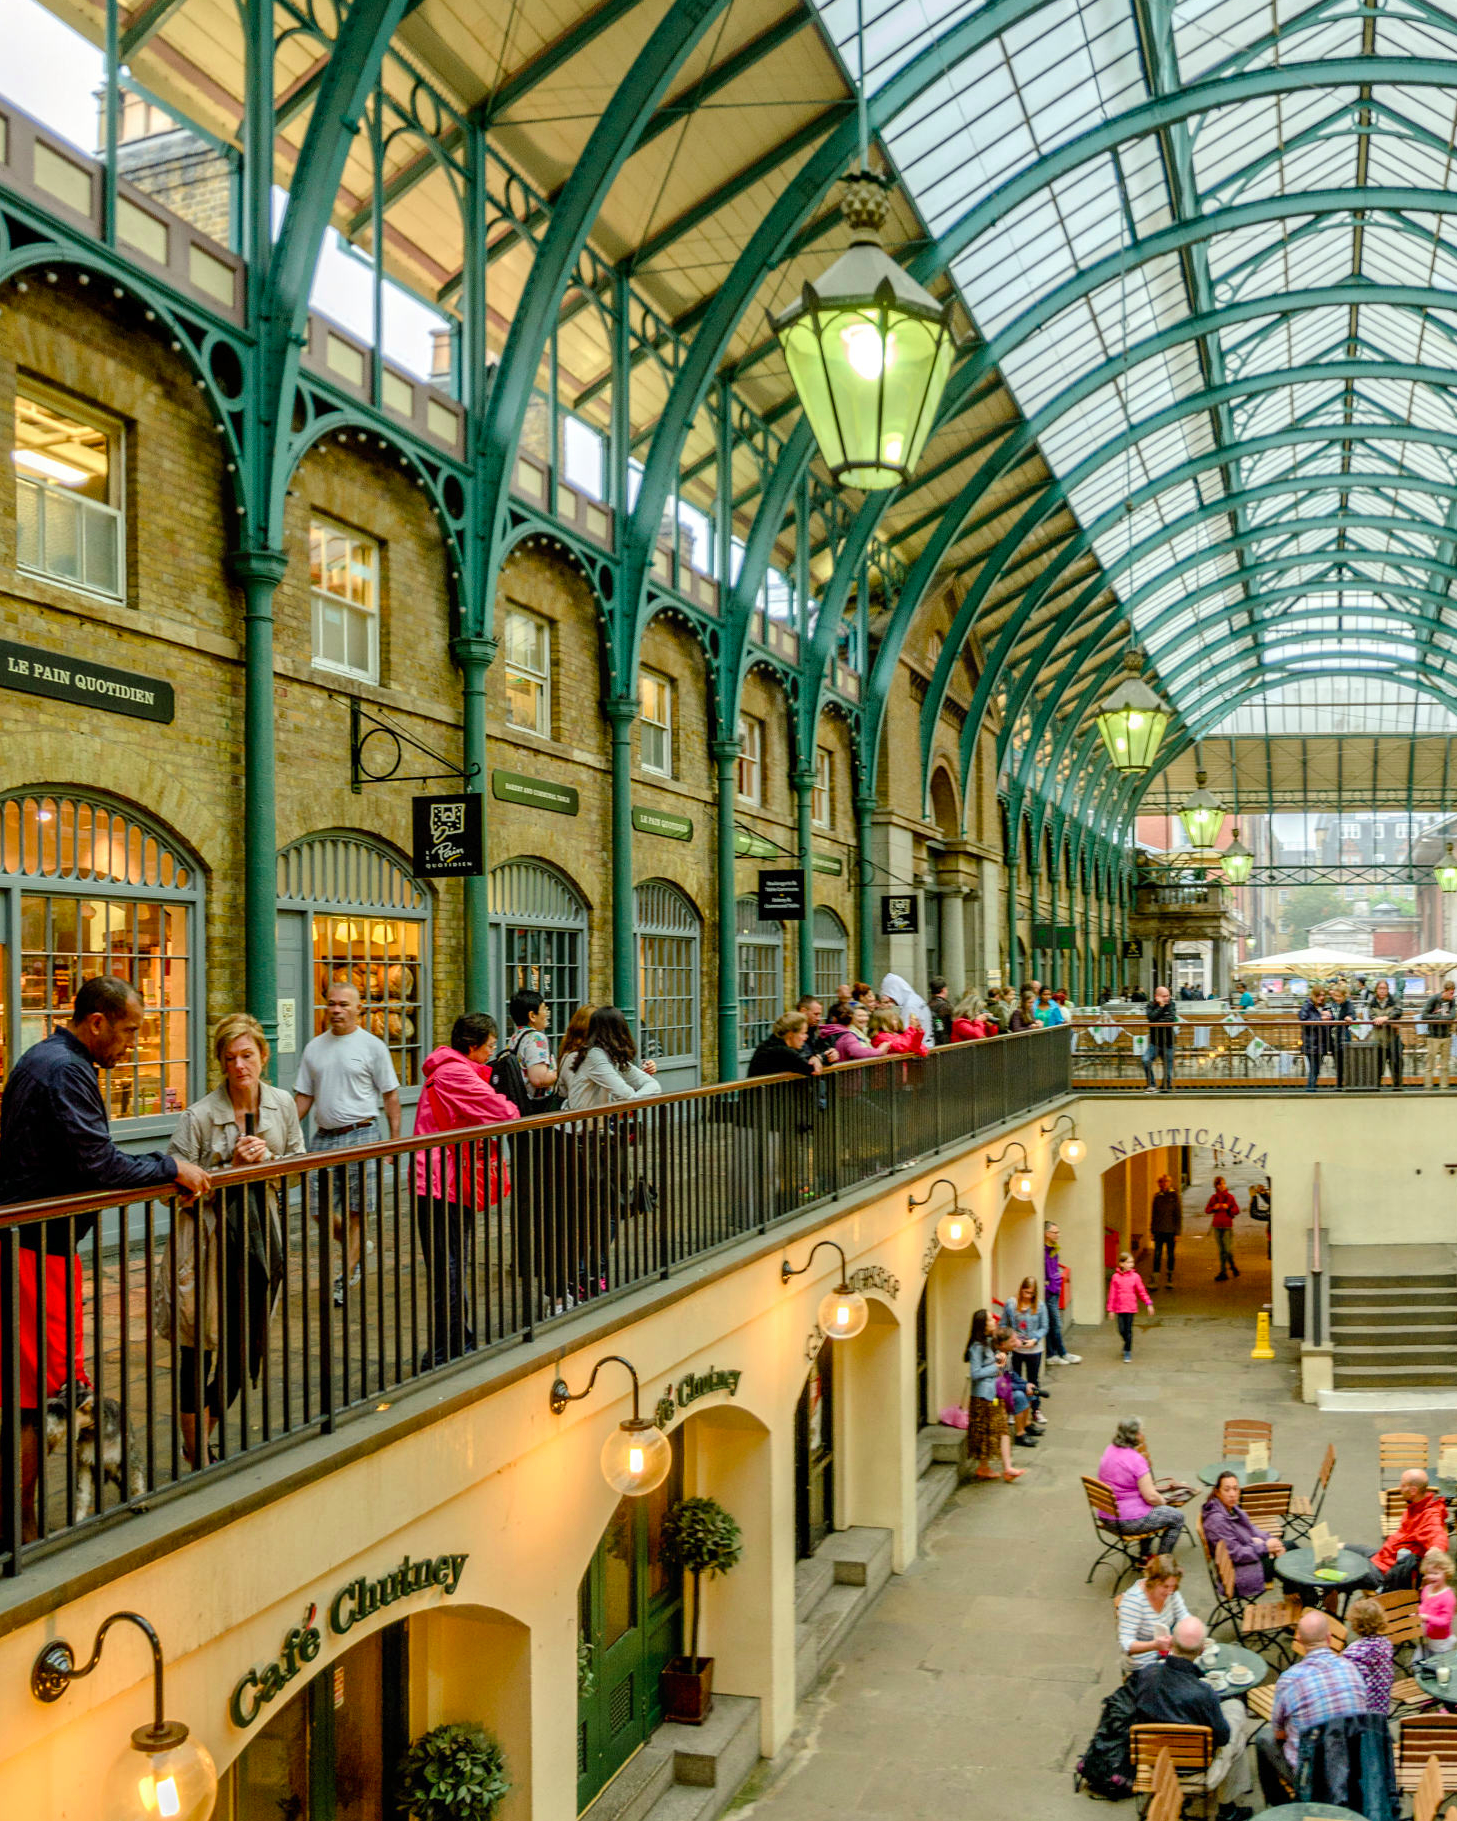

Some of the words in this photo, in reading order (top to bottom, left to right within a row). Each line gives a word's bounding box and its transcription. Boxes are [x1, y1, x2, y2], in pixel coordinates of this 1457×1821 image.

[7, 657, 30, 676] LE
[33, 663, 71, 685] PAIN
[75, 674, 155, 706] QUOTIDIEN
[425, 861, 473, 869] QUOTIDIEN
[431, 842, 465, 861] Pain
[1109, 1128, 1269, 1170] NAUTICALIA
[677, 1365, 742, 1407] Chutney
[229, 1602, 321, 1728] Café
[330, 1553, 469, 1635] Chutney
